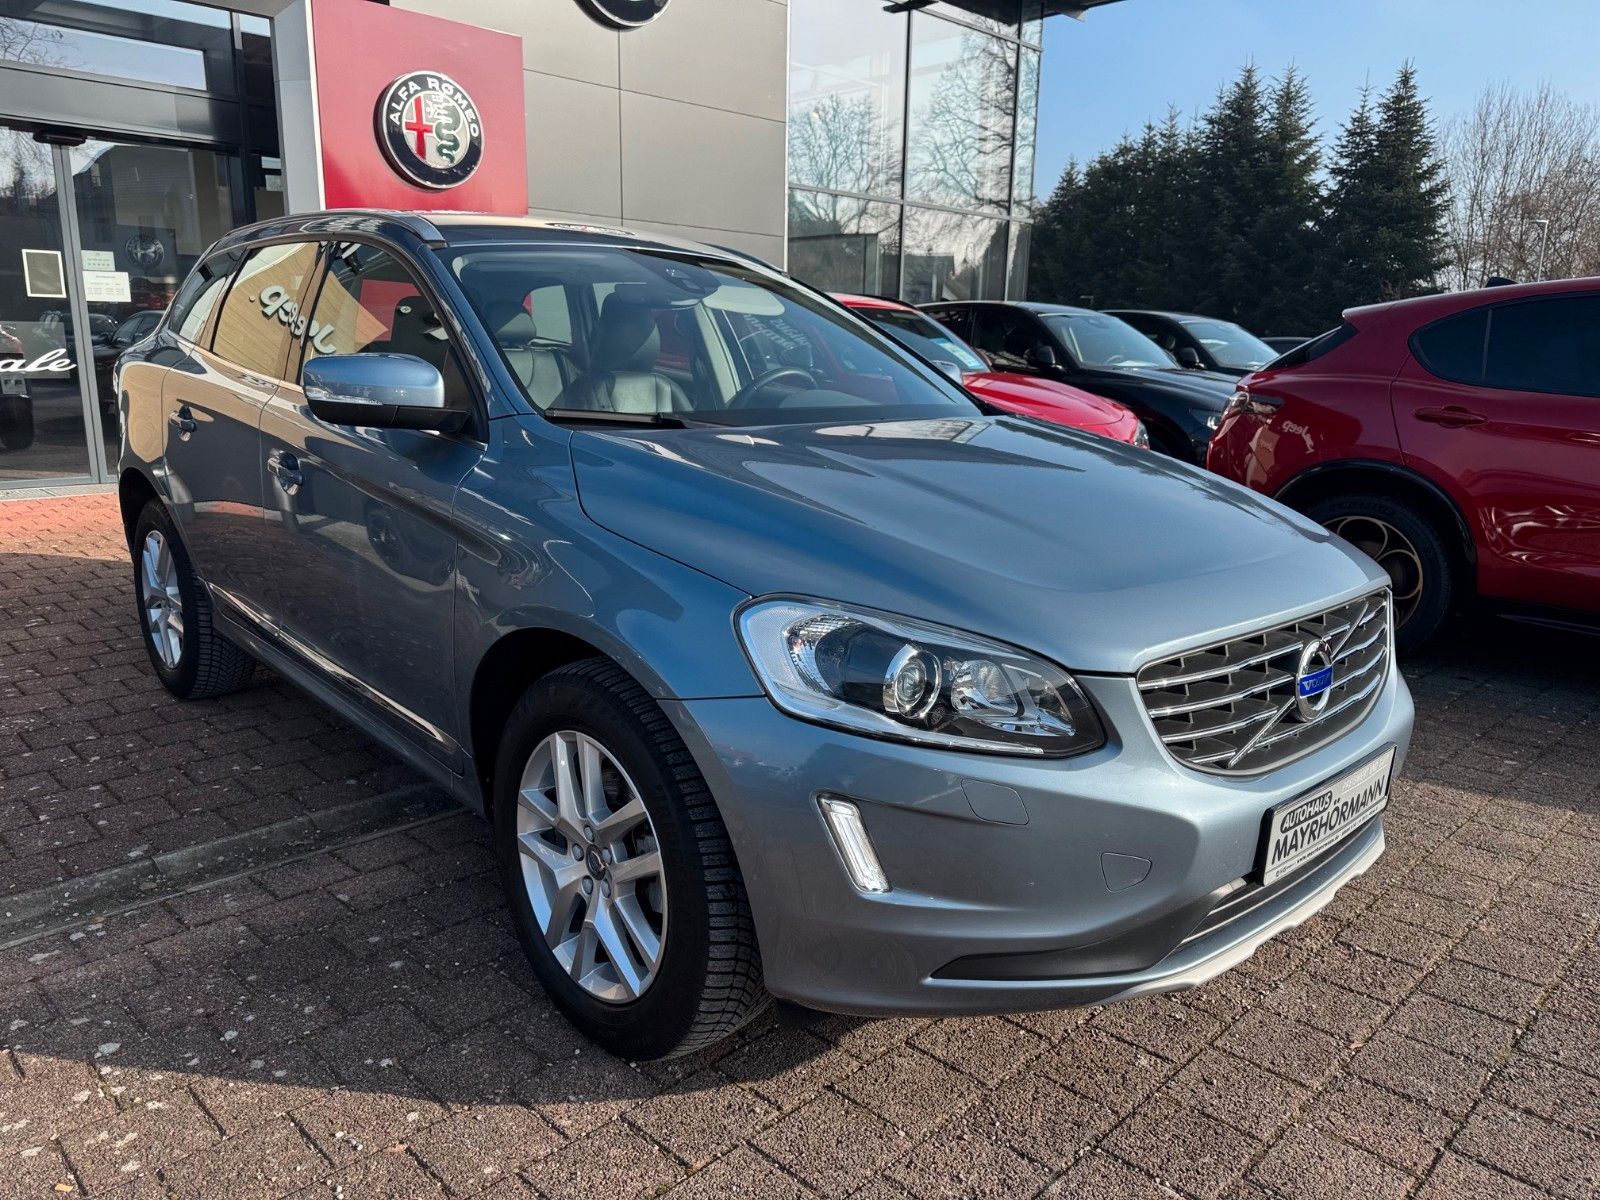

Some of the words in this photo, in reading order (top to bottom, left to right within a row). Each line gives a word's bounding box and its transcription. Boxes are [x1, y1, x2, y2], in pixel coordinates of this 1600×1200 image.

[389, 81, 422, 125] ALFA
[427, 77, 479, 137] ROMEO
[1272, 775, 1386, 866] MAYRHÖRMANN
[1282, 793, 1332, 831] AUTOHAUS
